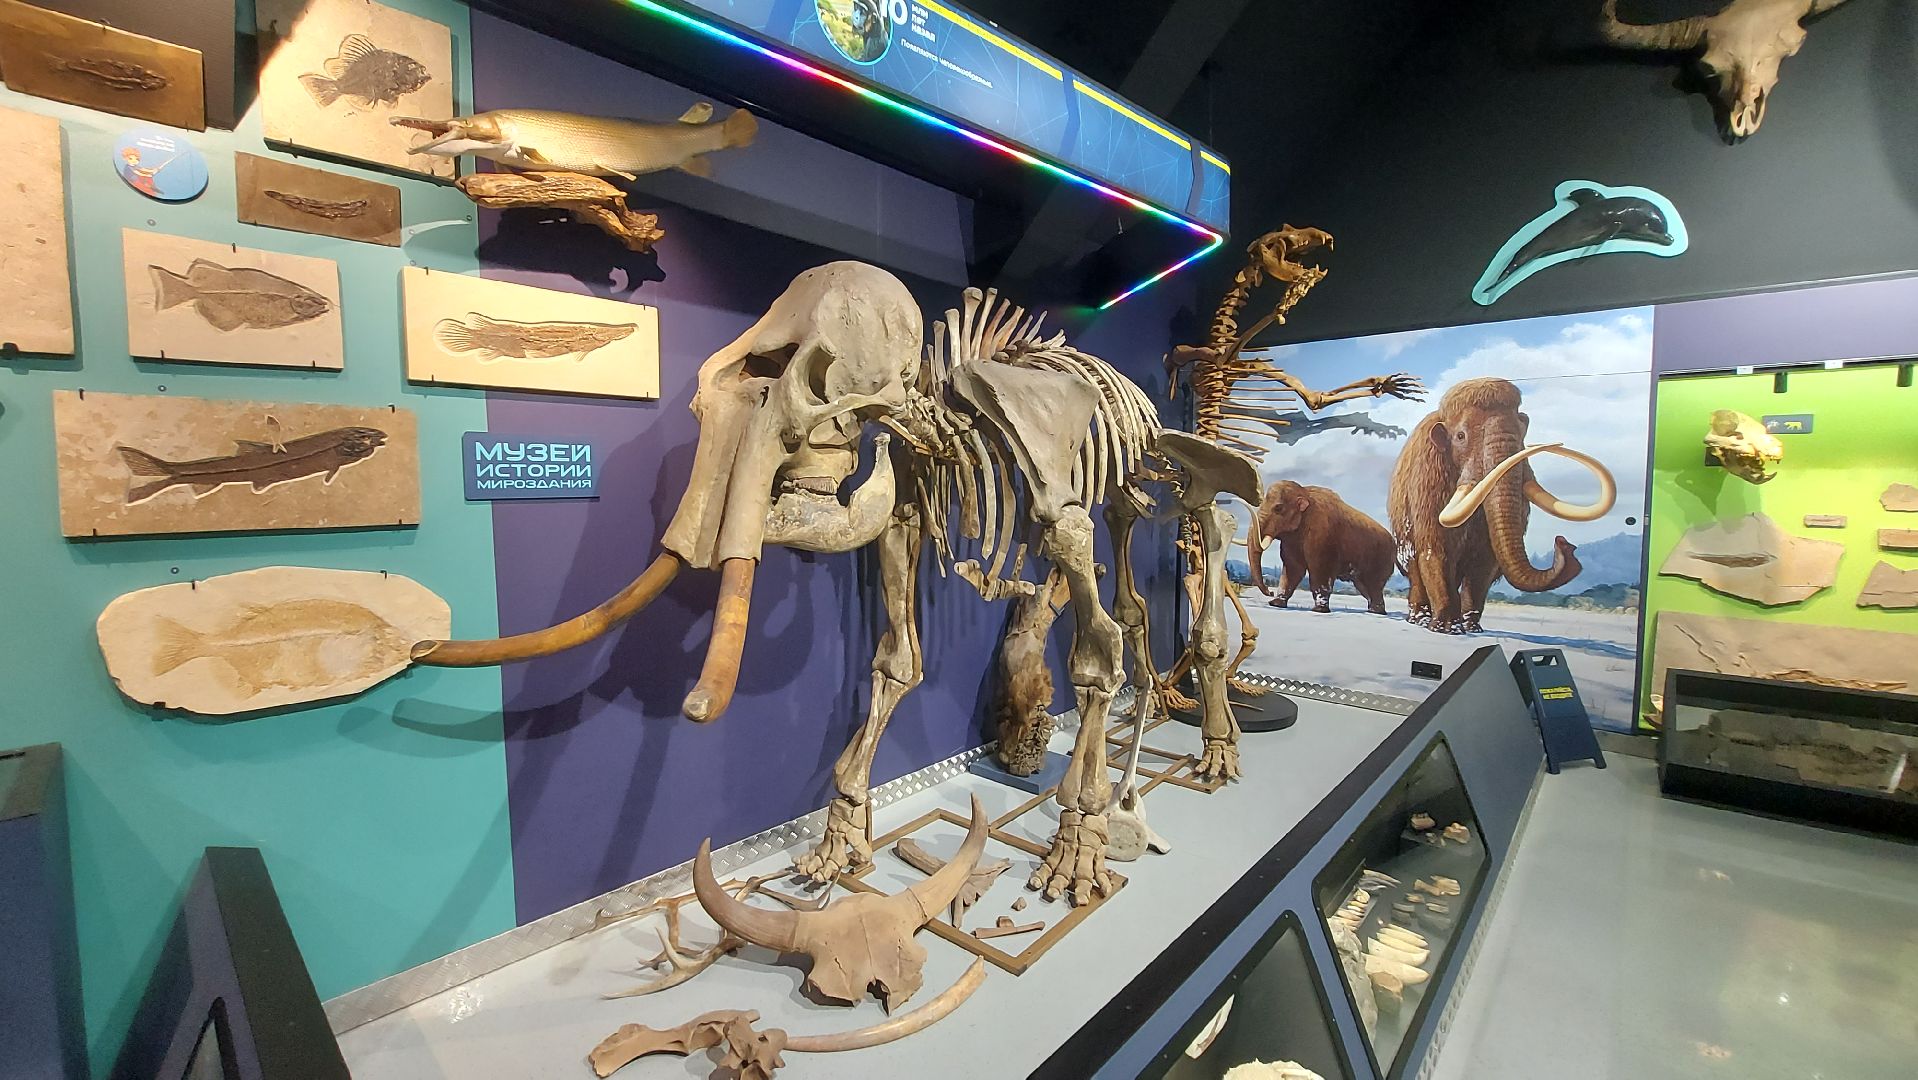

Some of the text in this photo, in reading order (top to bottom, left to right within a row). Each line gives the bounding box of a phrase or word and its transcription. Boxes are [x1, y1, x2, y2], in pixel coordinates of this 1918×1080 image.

[911, 4, 929, 20] млн
[911, 13, 926, 27] лет
[911, 23, 936, 43] назад
[901, 38, 938, 62] Появляются
[475, 442, 591, 463] МУЗЕЙ
[476, 463, 592, 478] ИСТОРИИ
[477, 479, 592, 489] МИРОЗДАНИЯ
